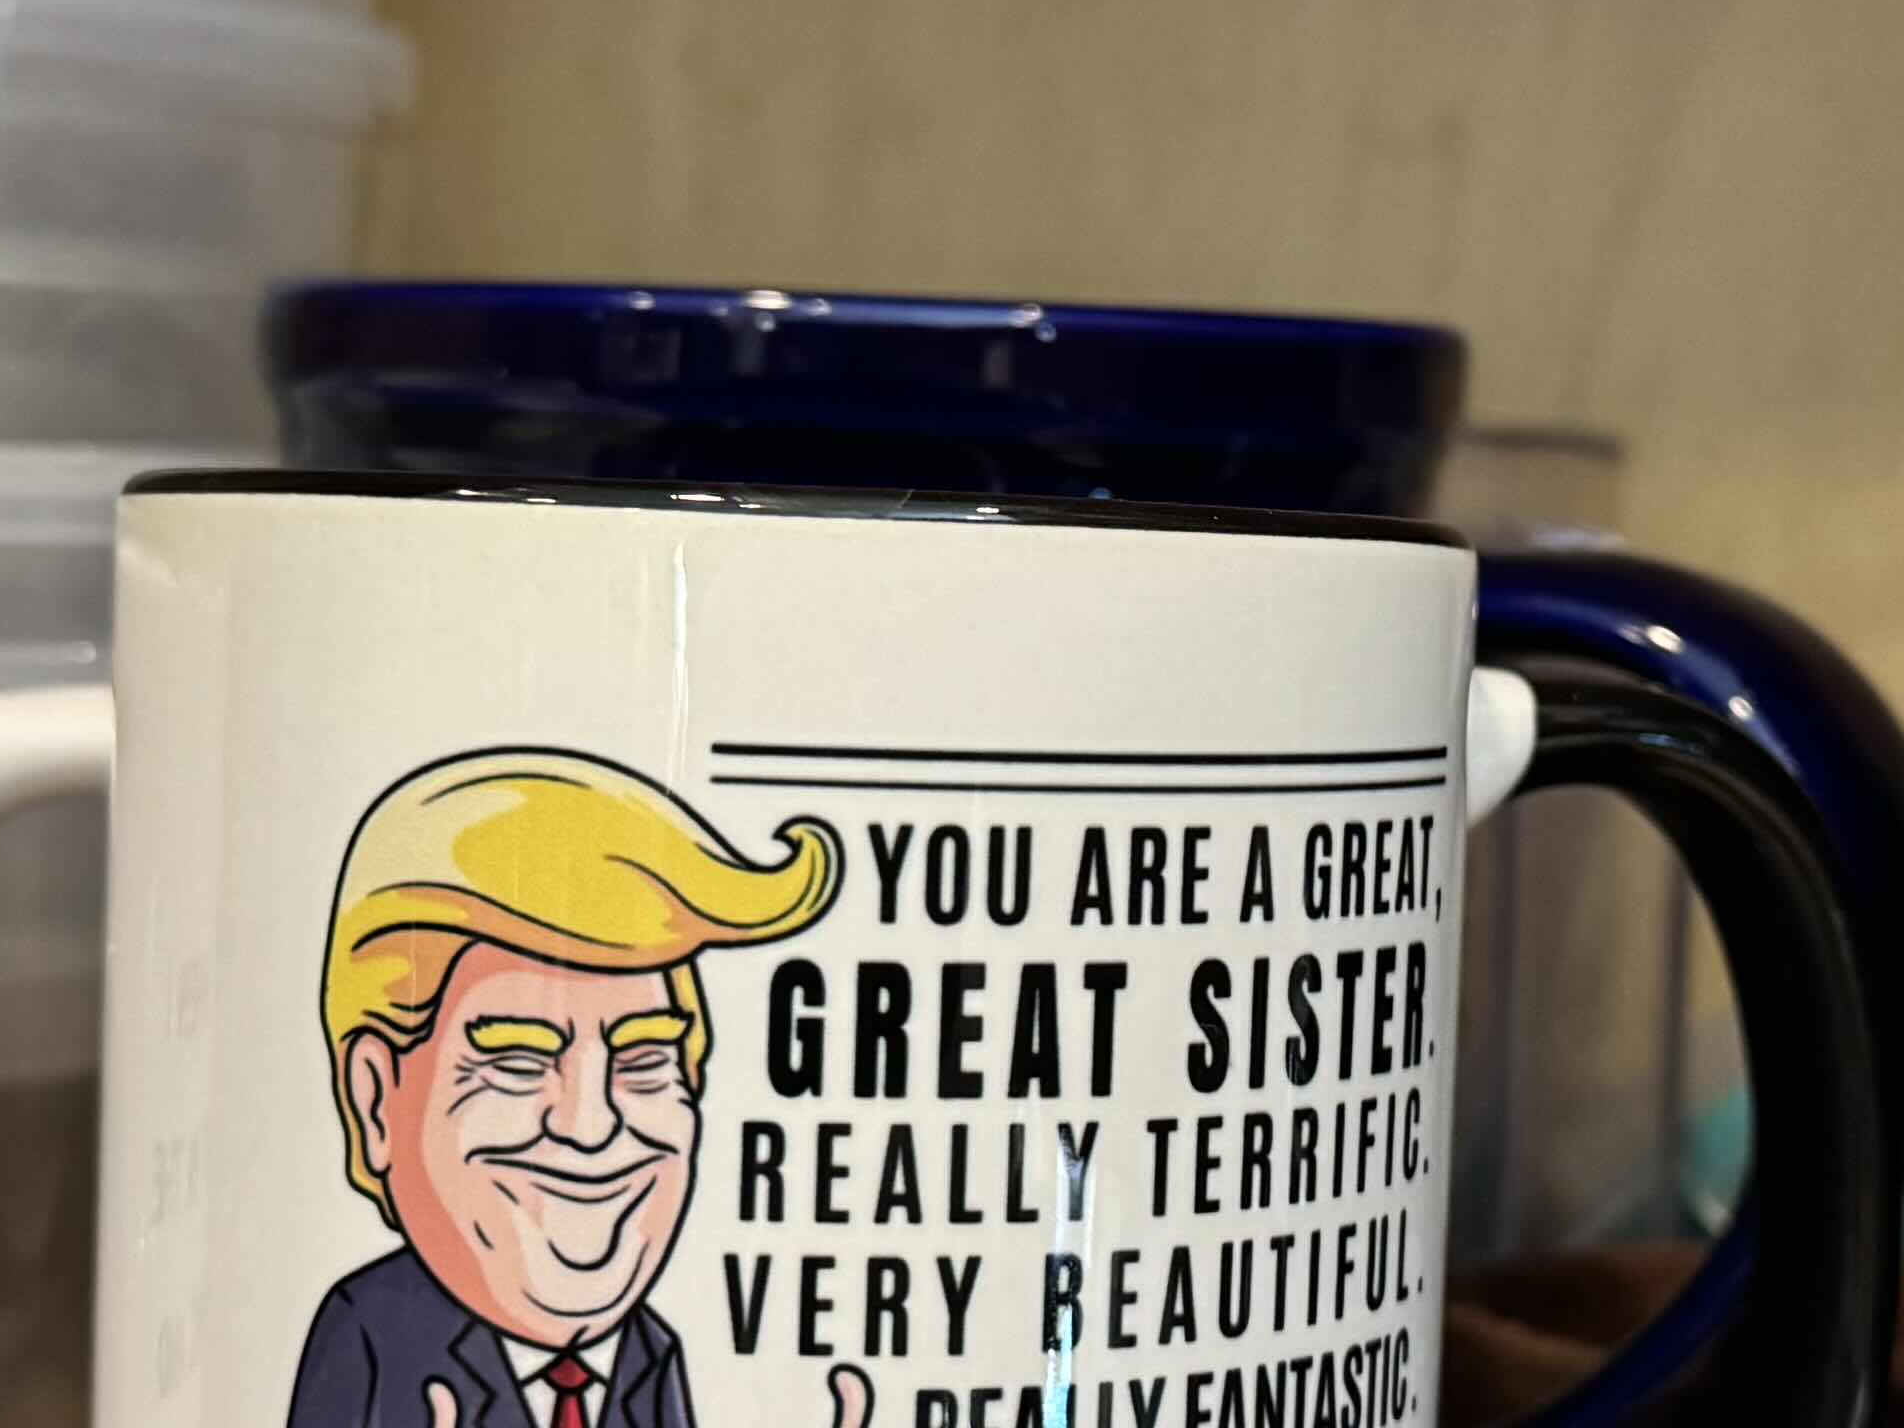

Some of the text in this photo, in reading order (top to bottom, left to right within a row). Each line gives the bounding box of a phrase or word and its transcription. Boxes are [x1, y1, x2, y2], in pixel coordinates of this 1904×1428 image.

[867, 814, 1443, 928] YOU ARE A GREAT,
[767, 940, 1436, 1101] GREAT SISTER.
[739, 1087, 1431, 1224] REALLY TERRIFIC.
[723, 1208, 1425, 1359] VERY BEAUTIFUL.
